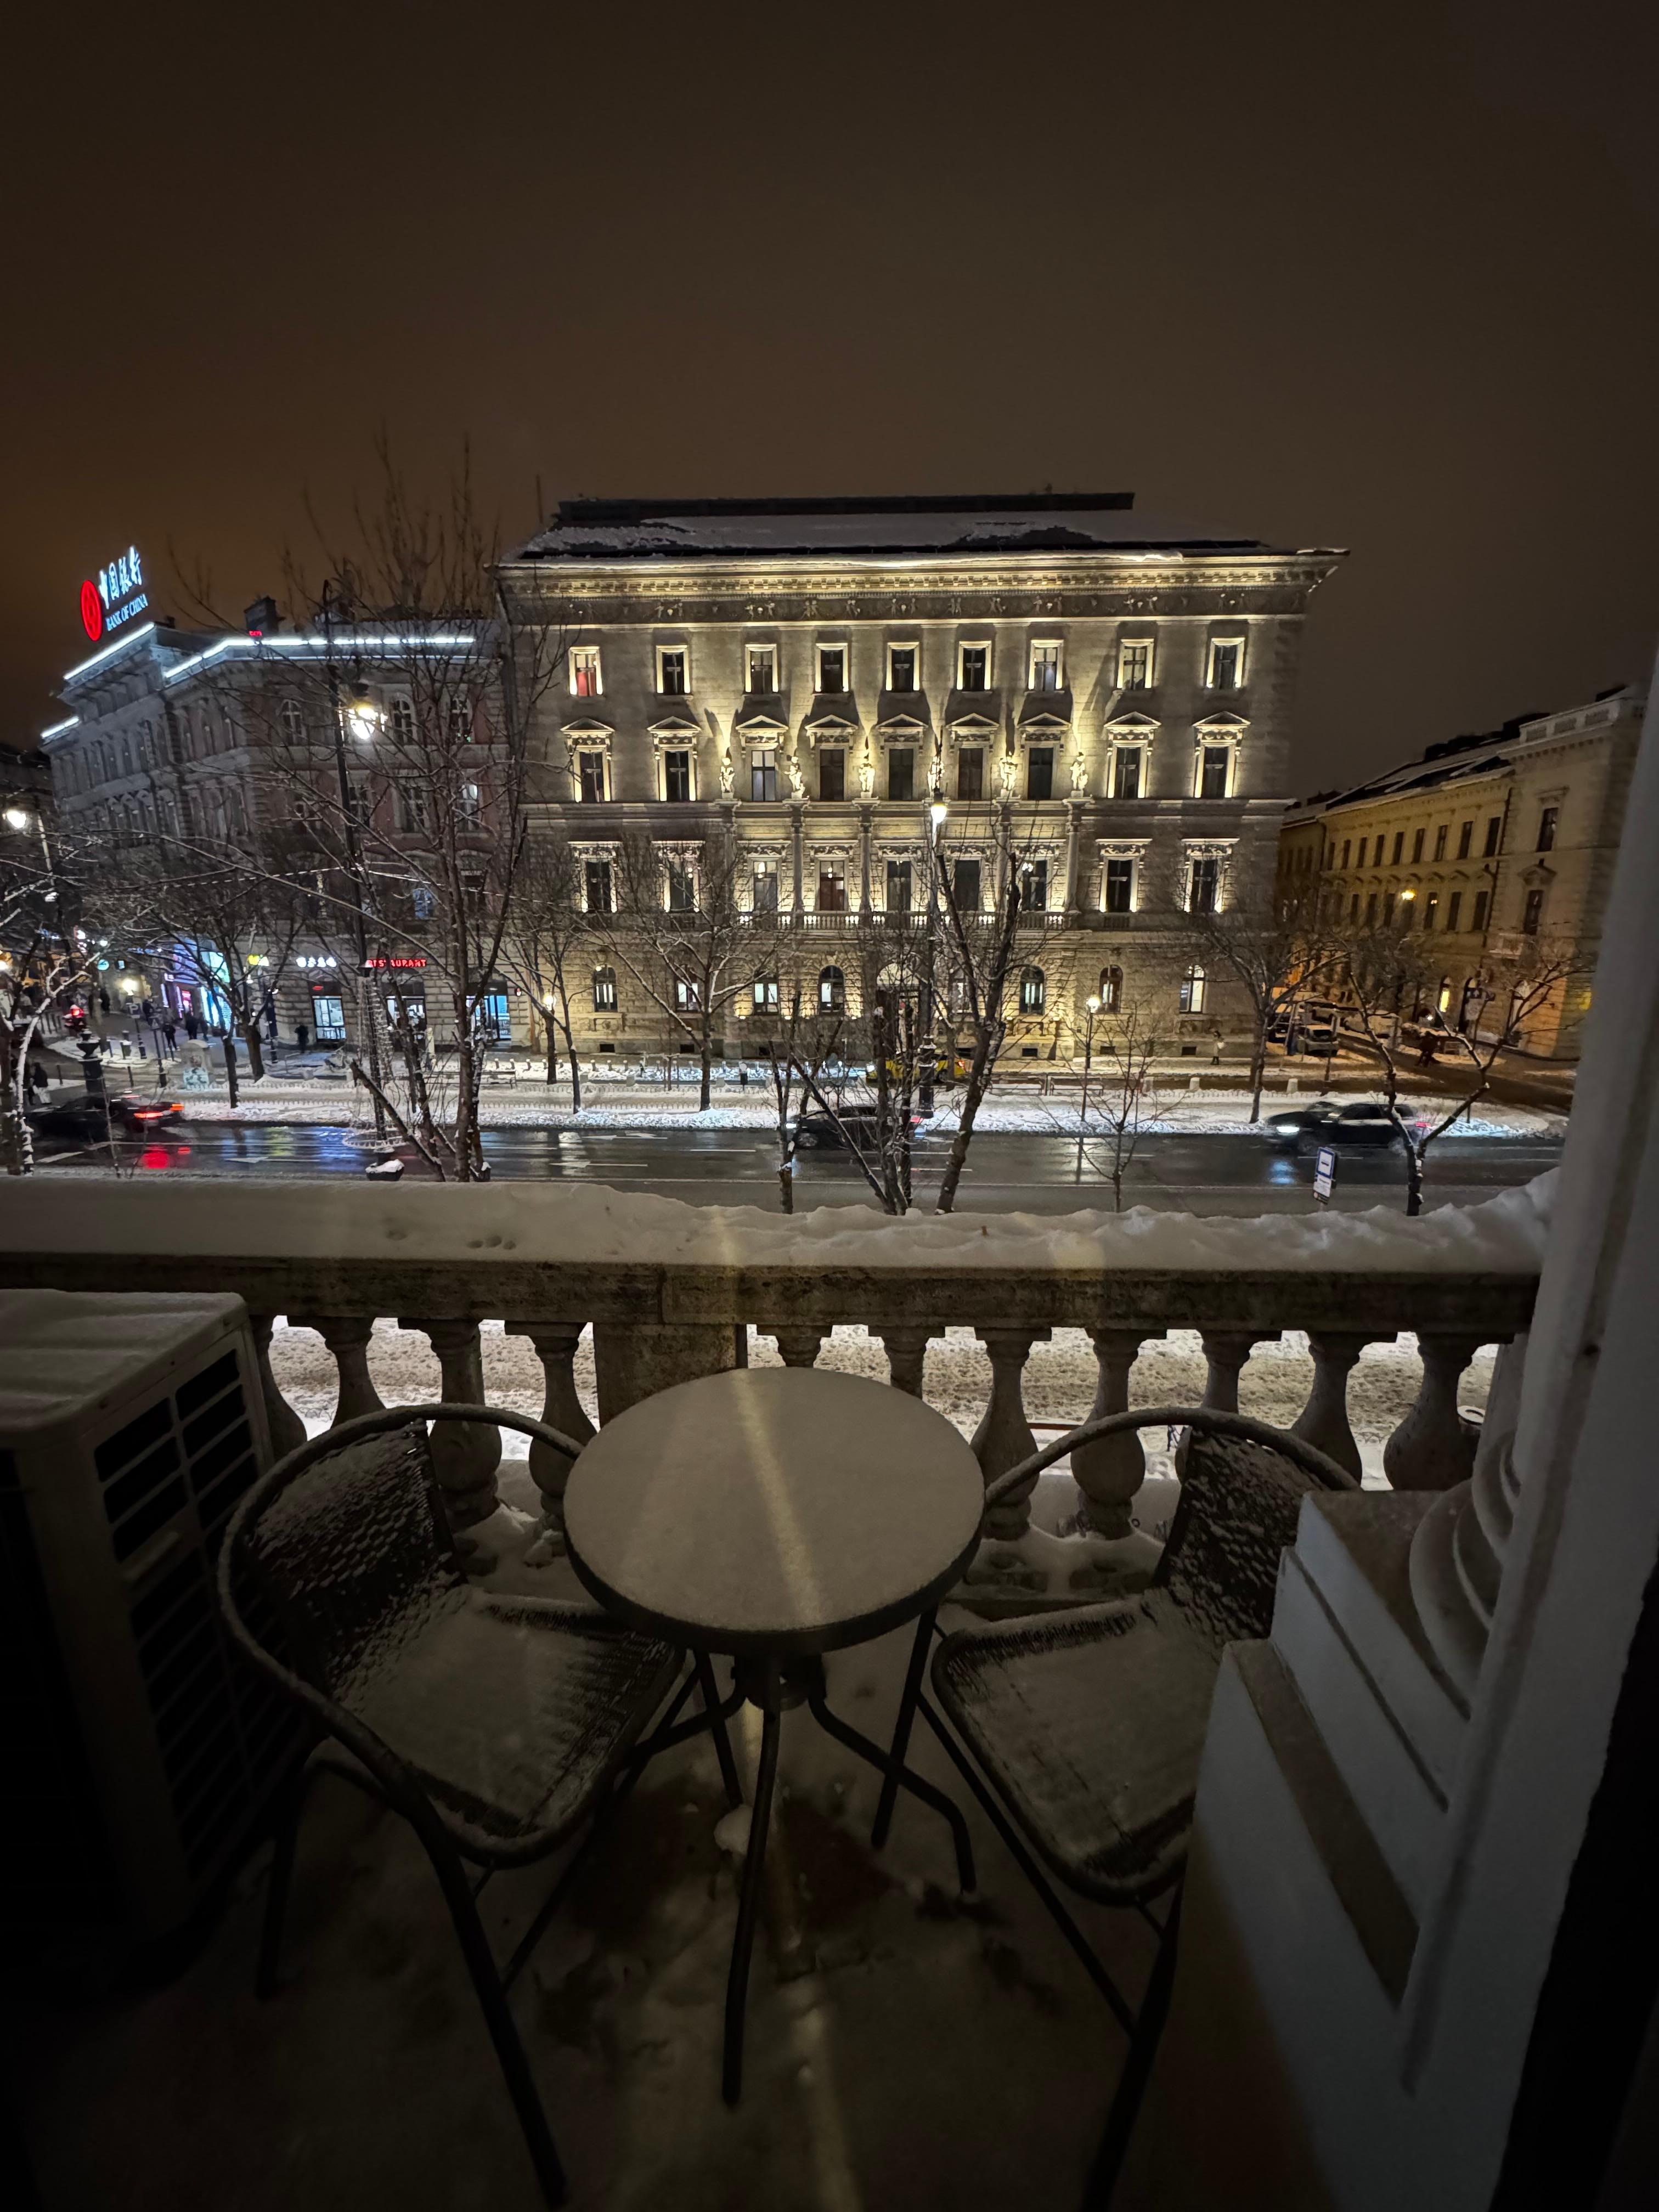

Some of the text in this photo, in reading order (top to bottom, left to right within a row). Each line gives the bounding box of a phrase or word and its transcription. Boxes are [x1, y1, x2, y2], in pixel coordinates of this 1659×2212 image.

[105, 594, 148, 631] BANK OF CHINA
[365, 959, 426, 968] RESAURANT
[129, 1004, 138, 1014] P
